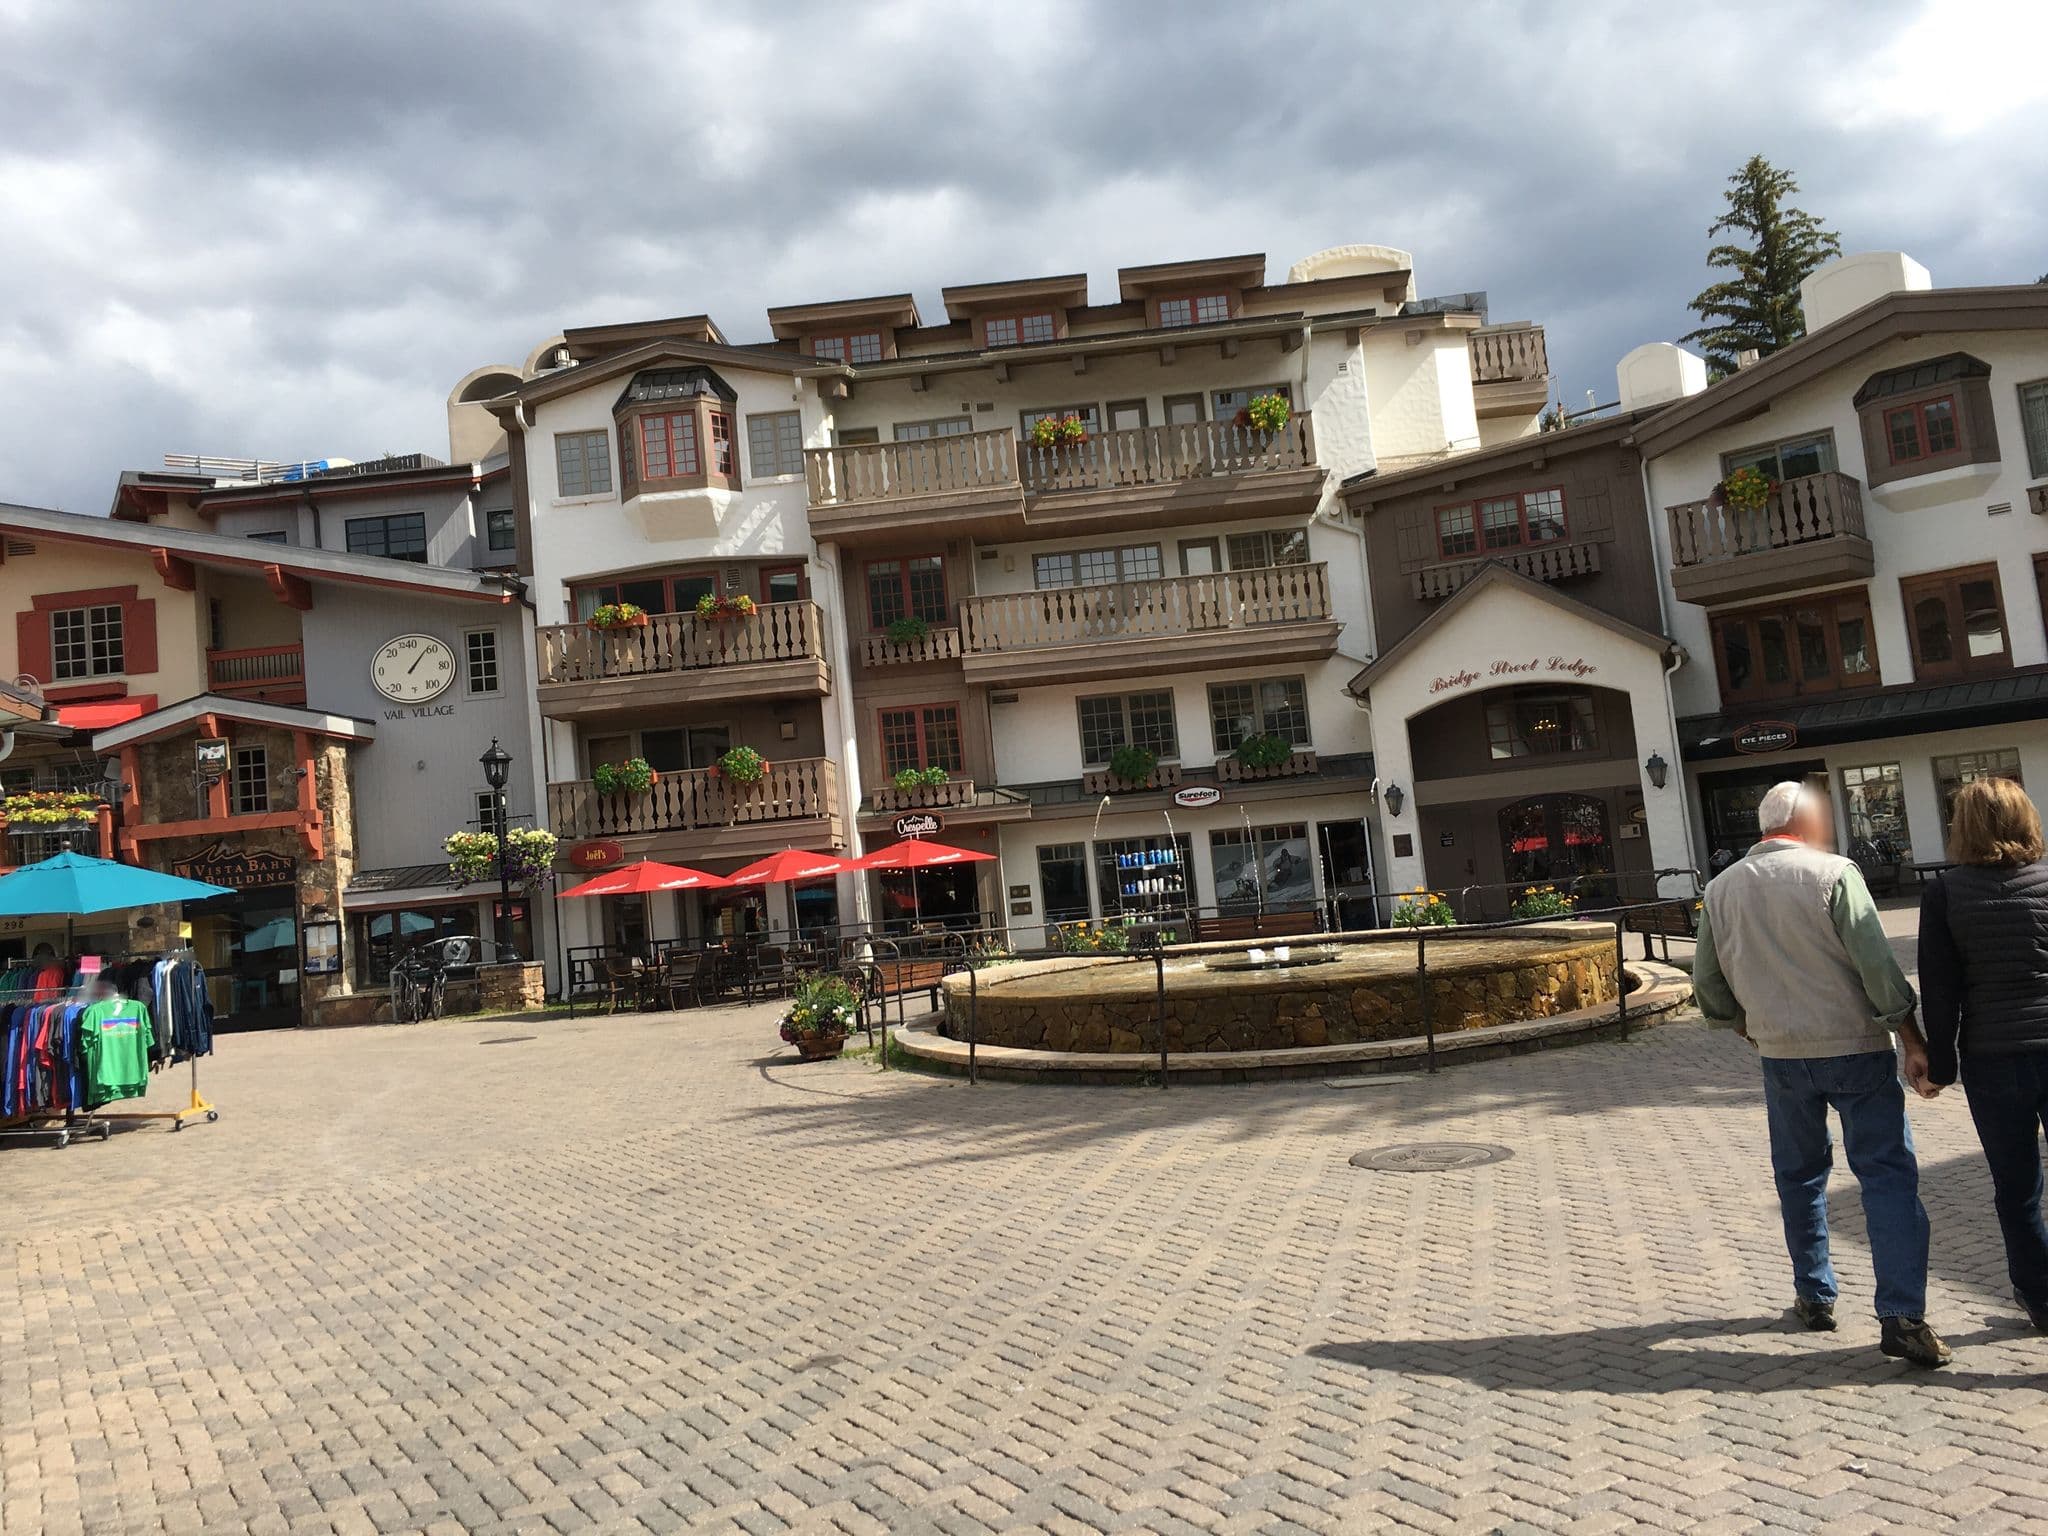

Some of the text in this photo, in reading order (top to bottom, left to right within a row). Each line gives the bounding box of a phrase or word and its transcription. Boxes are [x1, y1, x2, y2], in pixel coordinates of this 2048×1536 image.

[405, 640, 417, 649] 40
[426, 644, 438, 654] 60
[386, 648, 398, 658] 20
[438, 660, 450, 670] 80
[378, 667, 384, 676] 0
[1429, 656, 1600, 694] Bridge Street Lodge
[425, 680, 440, 690] 100
[384, 705, 455, 720] VAIL VILLAGE
[1759, 733, 1787, 742] PIECES
[1178, 790, 1217, 799] Surefoot
[897, 815, 938, 838] Crespelle
[194, 859, 291, 876] VISTA BAHN
[4, 919, 24, 930] 298
